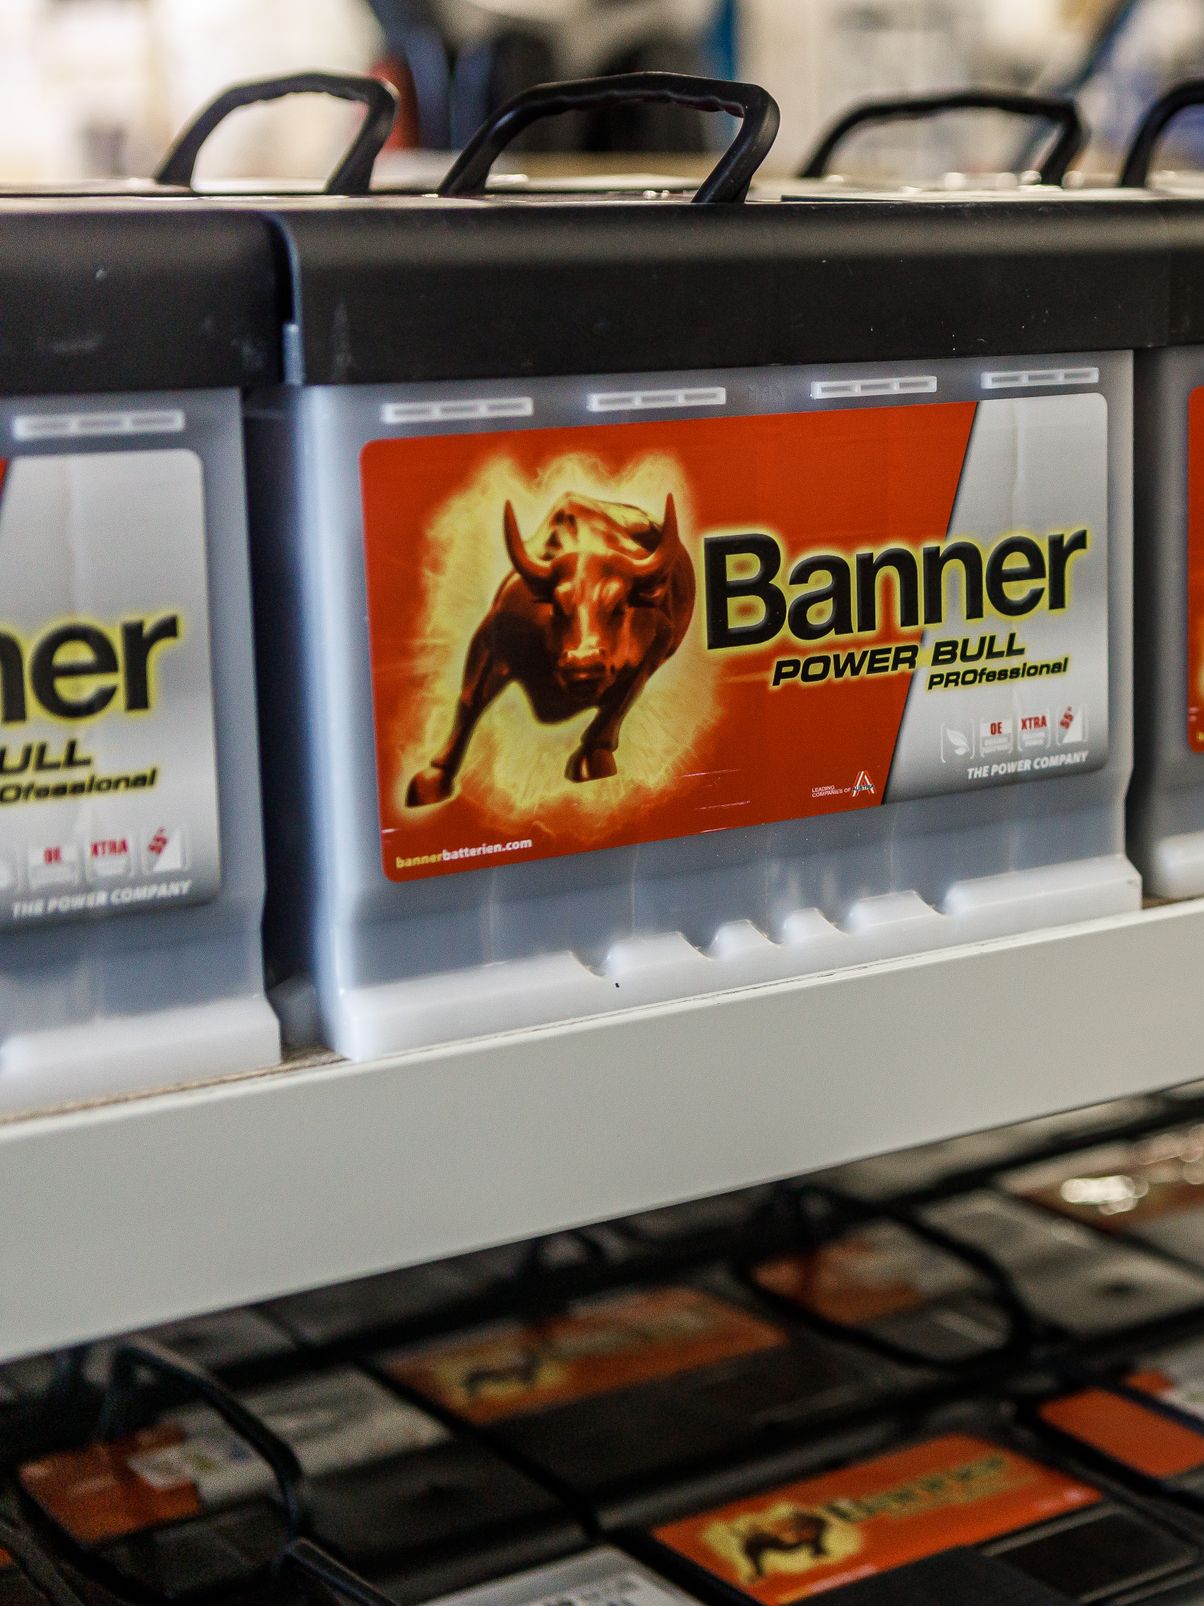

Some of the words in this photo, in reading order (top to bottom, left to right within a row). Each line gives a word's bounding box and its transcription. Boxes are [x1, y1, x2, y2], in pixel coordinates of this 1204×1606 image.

[703, 529, 1088, 650] Banner
[771, 644, 920, 687] POWER
[930, 632, 1026, 667] BULL
[927, 657, 1070, 691] PROfessional
[990, 722, 1003, 735] OE
[1021, 715, 1047, 730] XTRA
[967, 766, 989, 780] THE
[990, 759, 1031, 777] POWER
[1033, 750, 1089, 769] COMPANY
[395, 839, 533, 869] bannerbatterien.com
[47, 891, 108, 913] POWER
[110, 880, 192, 905] COMPANY
